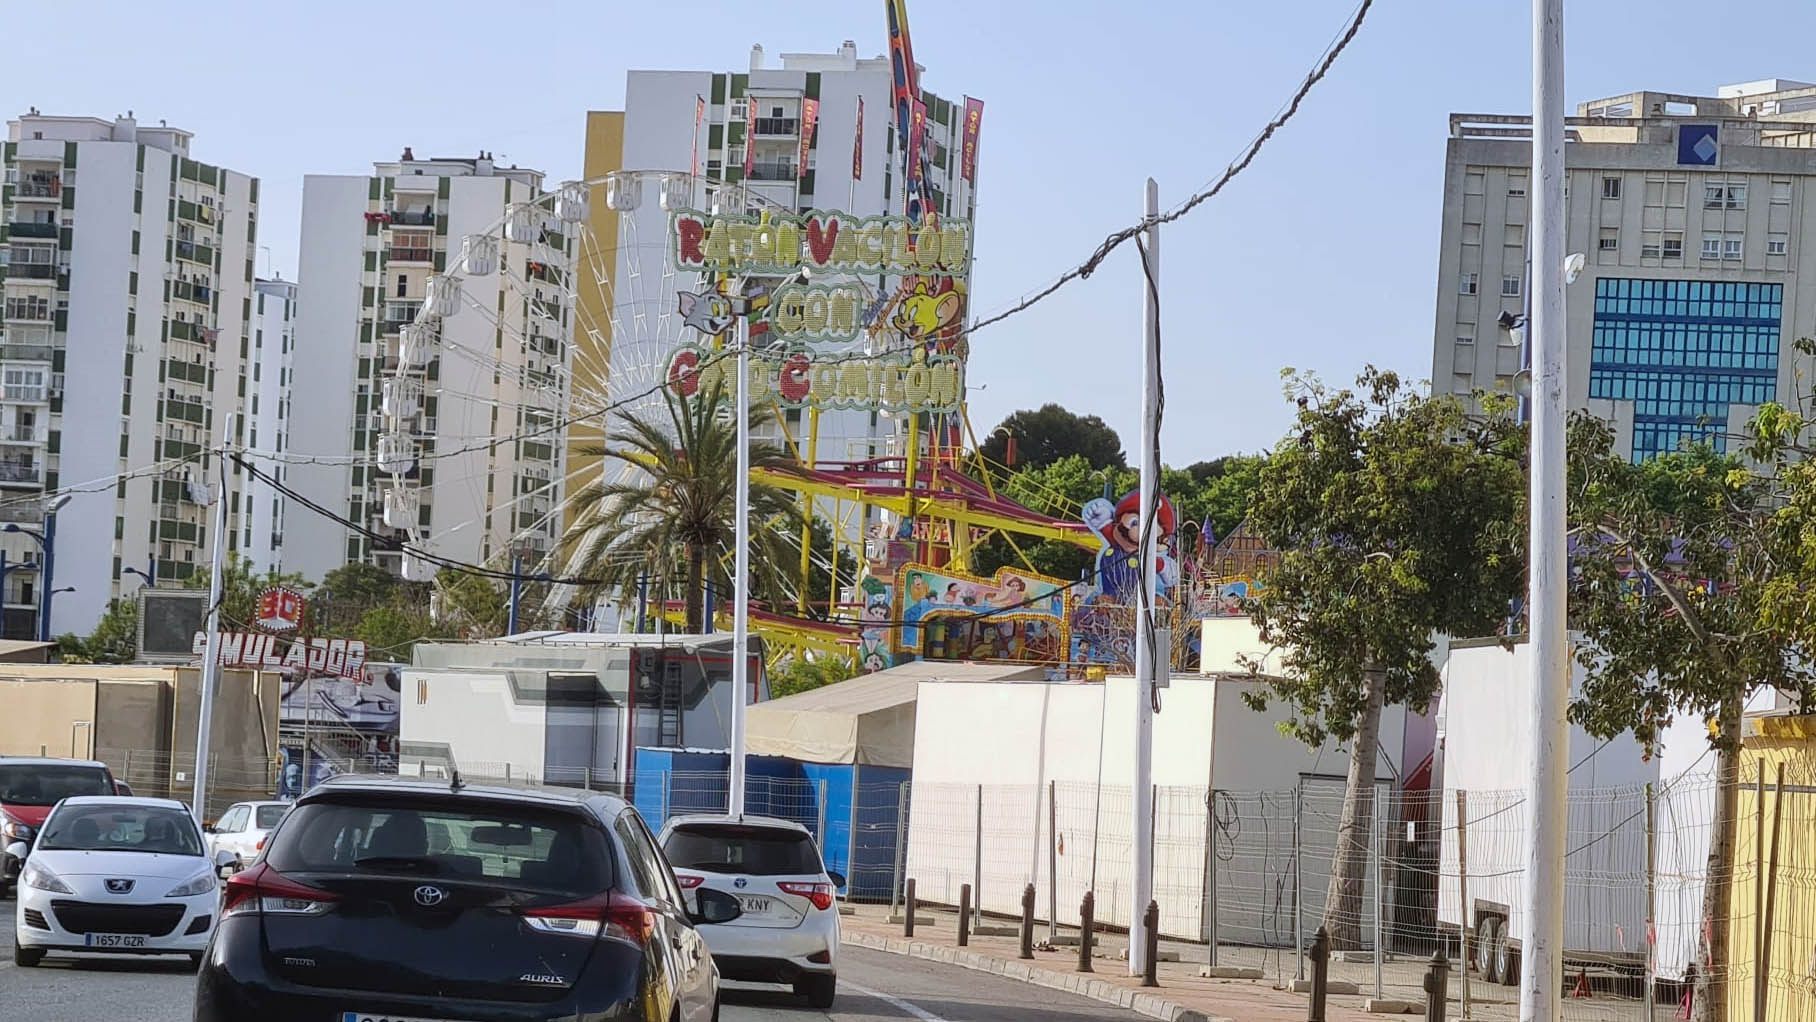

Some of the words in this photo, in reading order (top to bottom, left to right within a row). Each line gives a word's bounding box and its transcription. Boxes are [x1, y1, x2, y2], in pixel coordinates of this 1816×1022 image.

[778, 288, 856, 335] CON
[747, 898, 770, 911] KNY
[96, 935, 121, 946] 1657
[123, 936, 145, 947] GZR
[520, 974, 564, 984] AURIS
